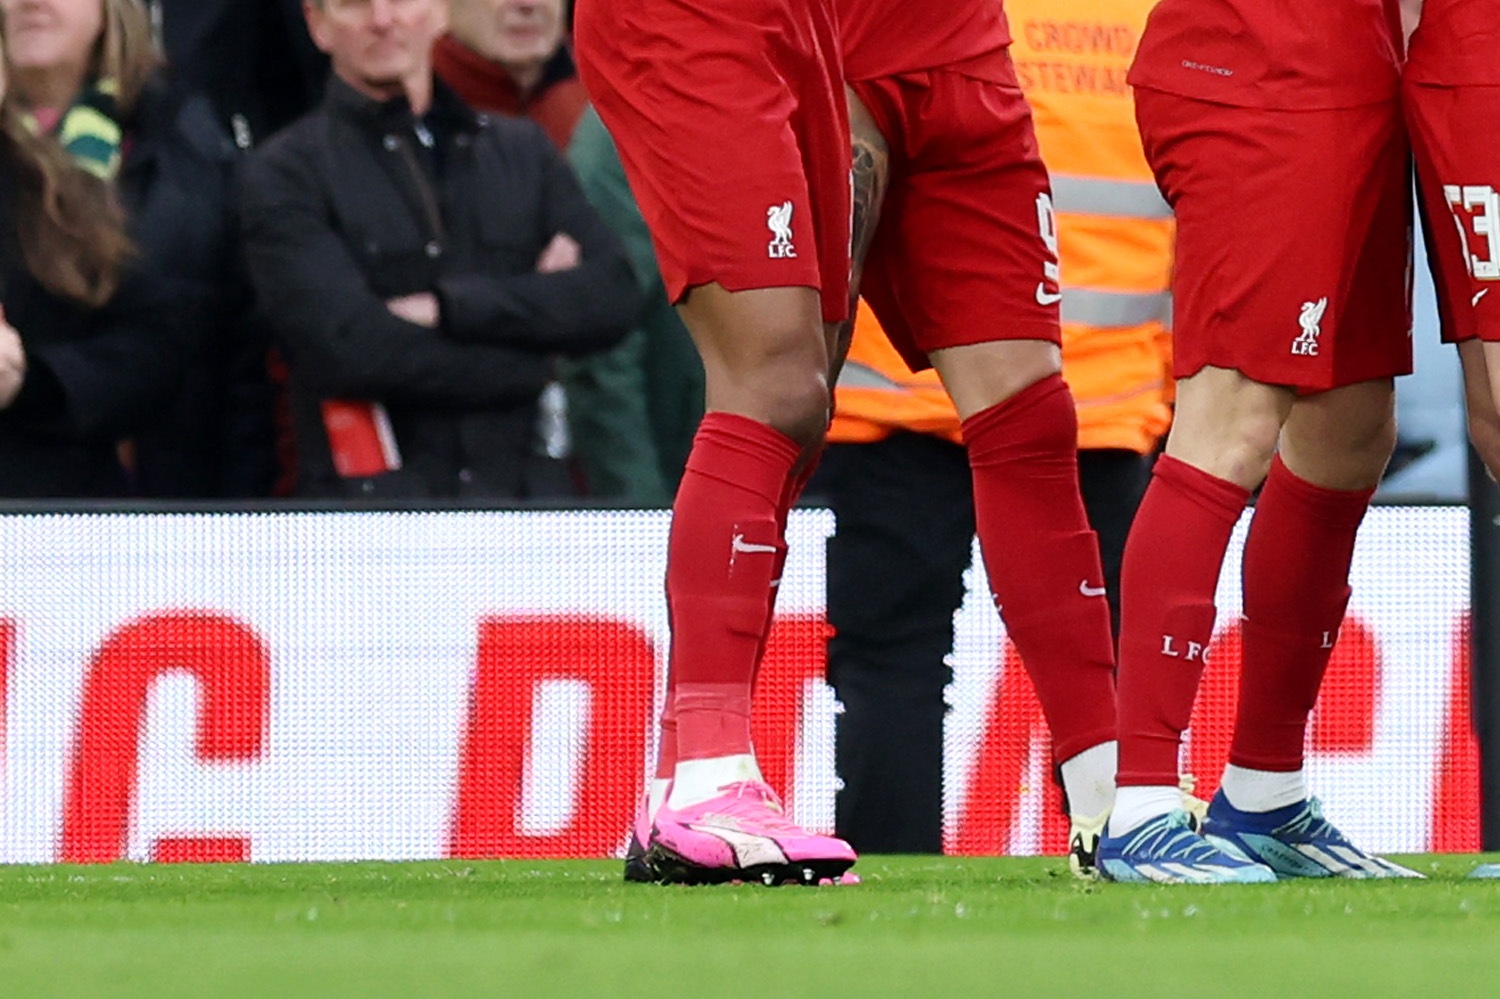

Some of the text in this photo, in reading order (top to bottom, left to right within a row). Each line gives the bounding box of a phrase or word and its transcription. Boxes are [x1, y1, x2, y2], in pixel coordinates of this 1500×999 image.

[1023, 19, 1135, 58] CROWD
[767, 243, 798, 258] LFC
[1290, 340, 1319, 357] LFC
